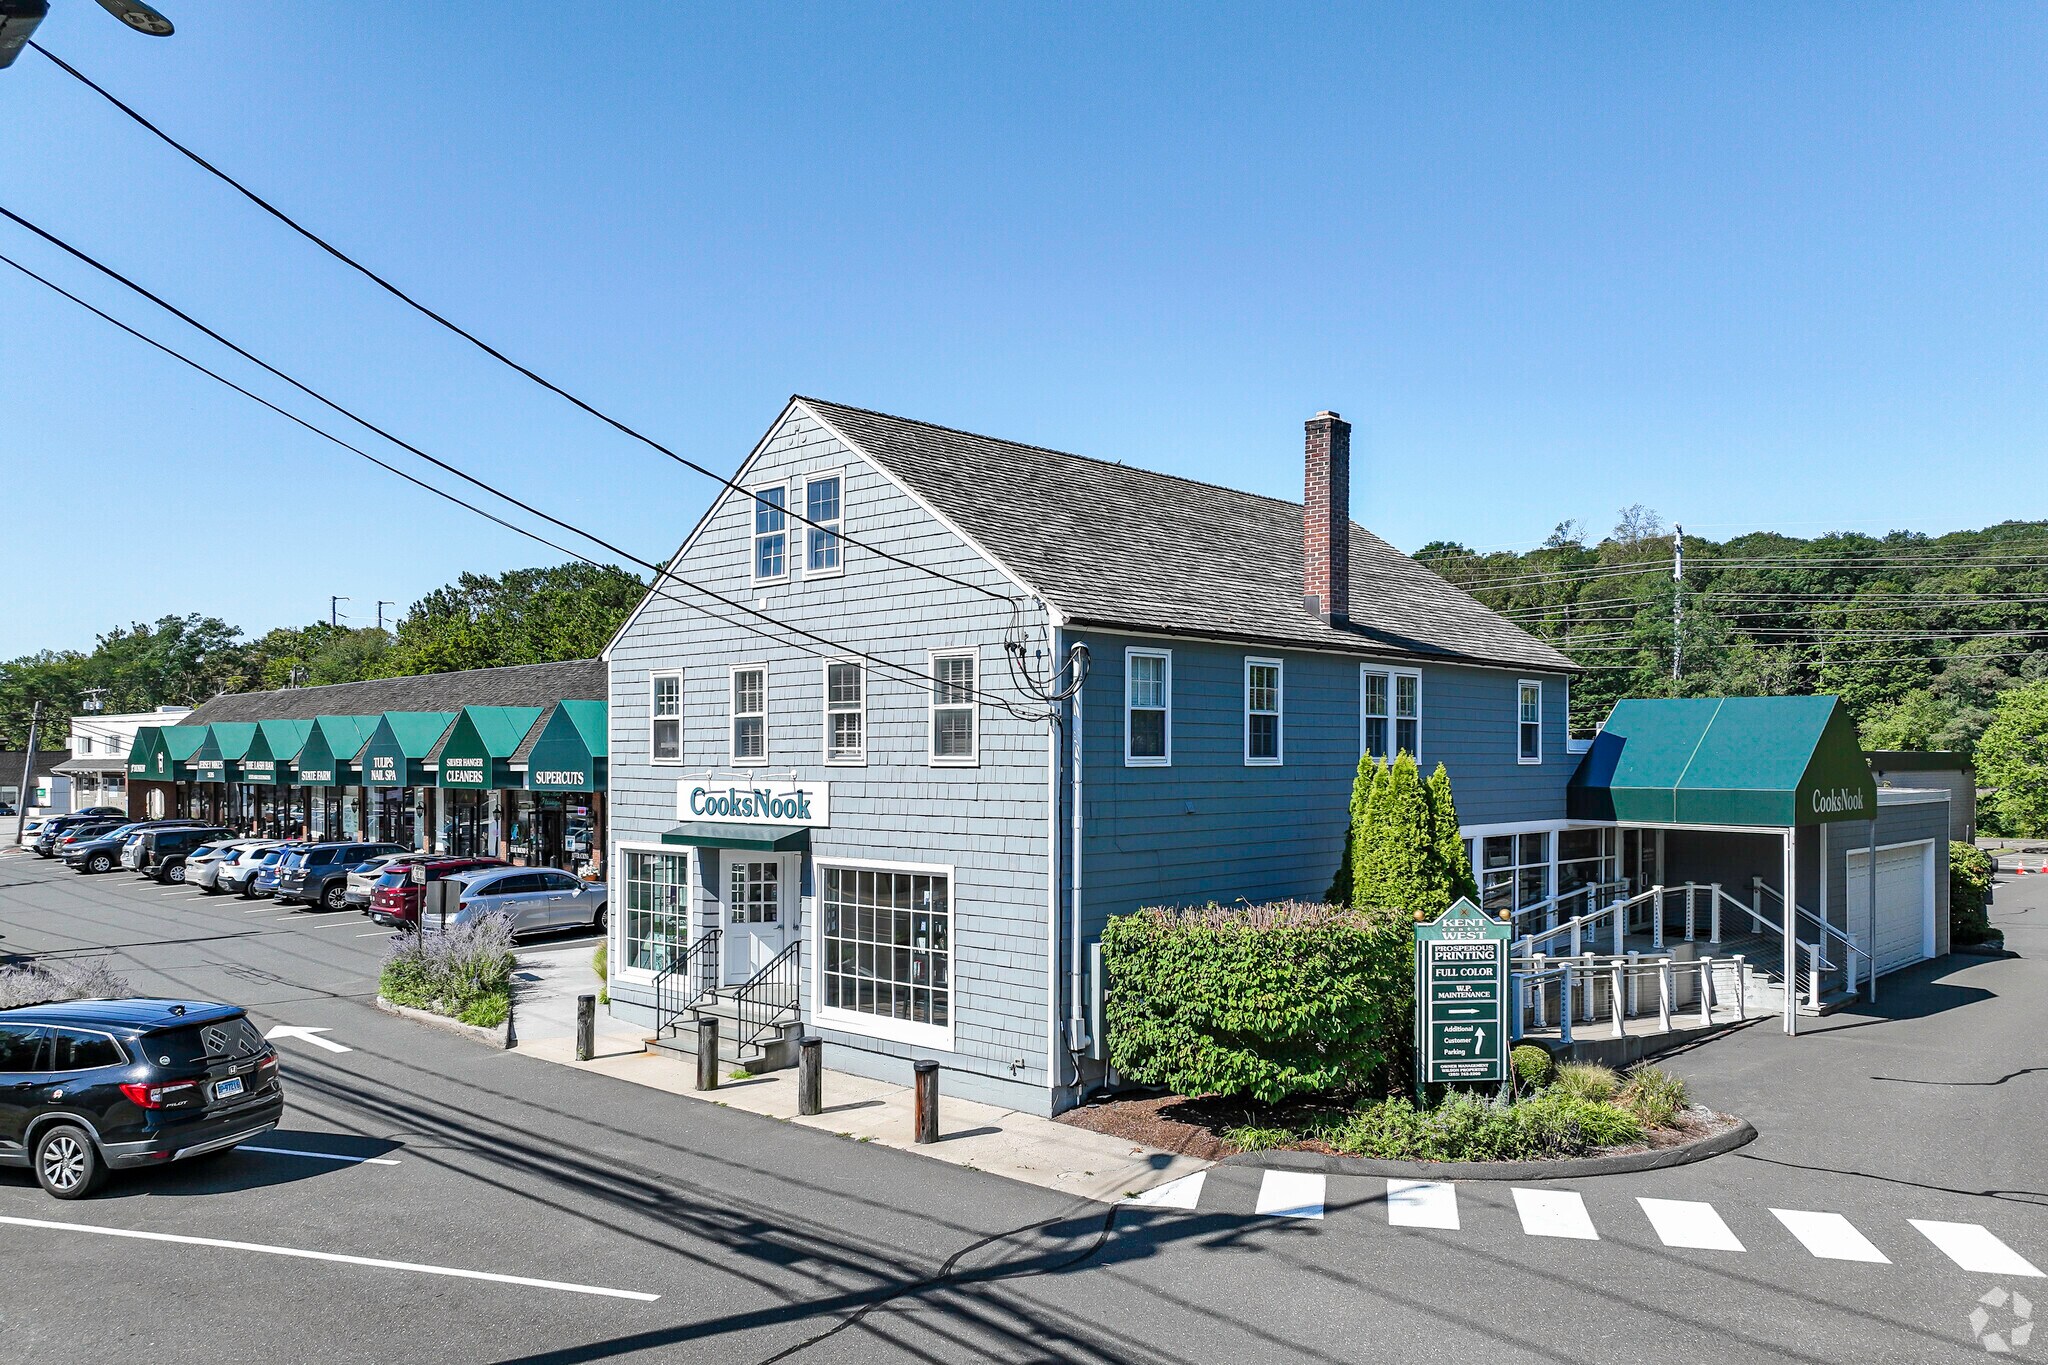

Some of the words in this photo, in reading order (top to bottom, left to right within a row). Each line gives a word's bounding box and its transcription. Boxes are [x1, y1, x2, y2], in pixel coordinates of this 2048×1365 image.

[373, 757, 394, 768] TULIPS
[446, 758, 462, 767] SILVER
[463, 758, 484, 767] HANGER
[301, 770, 317, 781] STATE
[317, 770, 332, 781] FARM
[371, 770, 384, 781] NAIL
[384, 770, 397, 781] SPA
[446, 770, 484, 783] CLEANERS
[535, 771, 584, 785] SUPERCUTS
[690, 787, 812, 820] CooksNook
[1812, 787, 1864, 813] CooksNook
[1441, 918, 1487, 927] KENT
[1441, 931, 1487, 940] WEST
[1434, 951, 1495, 960] PRINTING
[1435, 968, 1458, 977] FULL
[1460, 967, 1494, 976] COLOR
[1438, 991, 1491, 999] MAINTENANCE
[1444, 1025, 1474, 1033] Additional
[1444, 1048, 1466, 1057] Parking
[166, 1100, 188, 1108] PILOT
